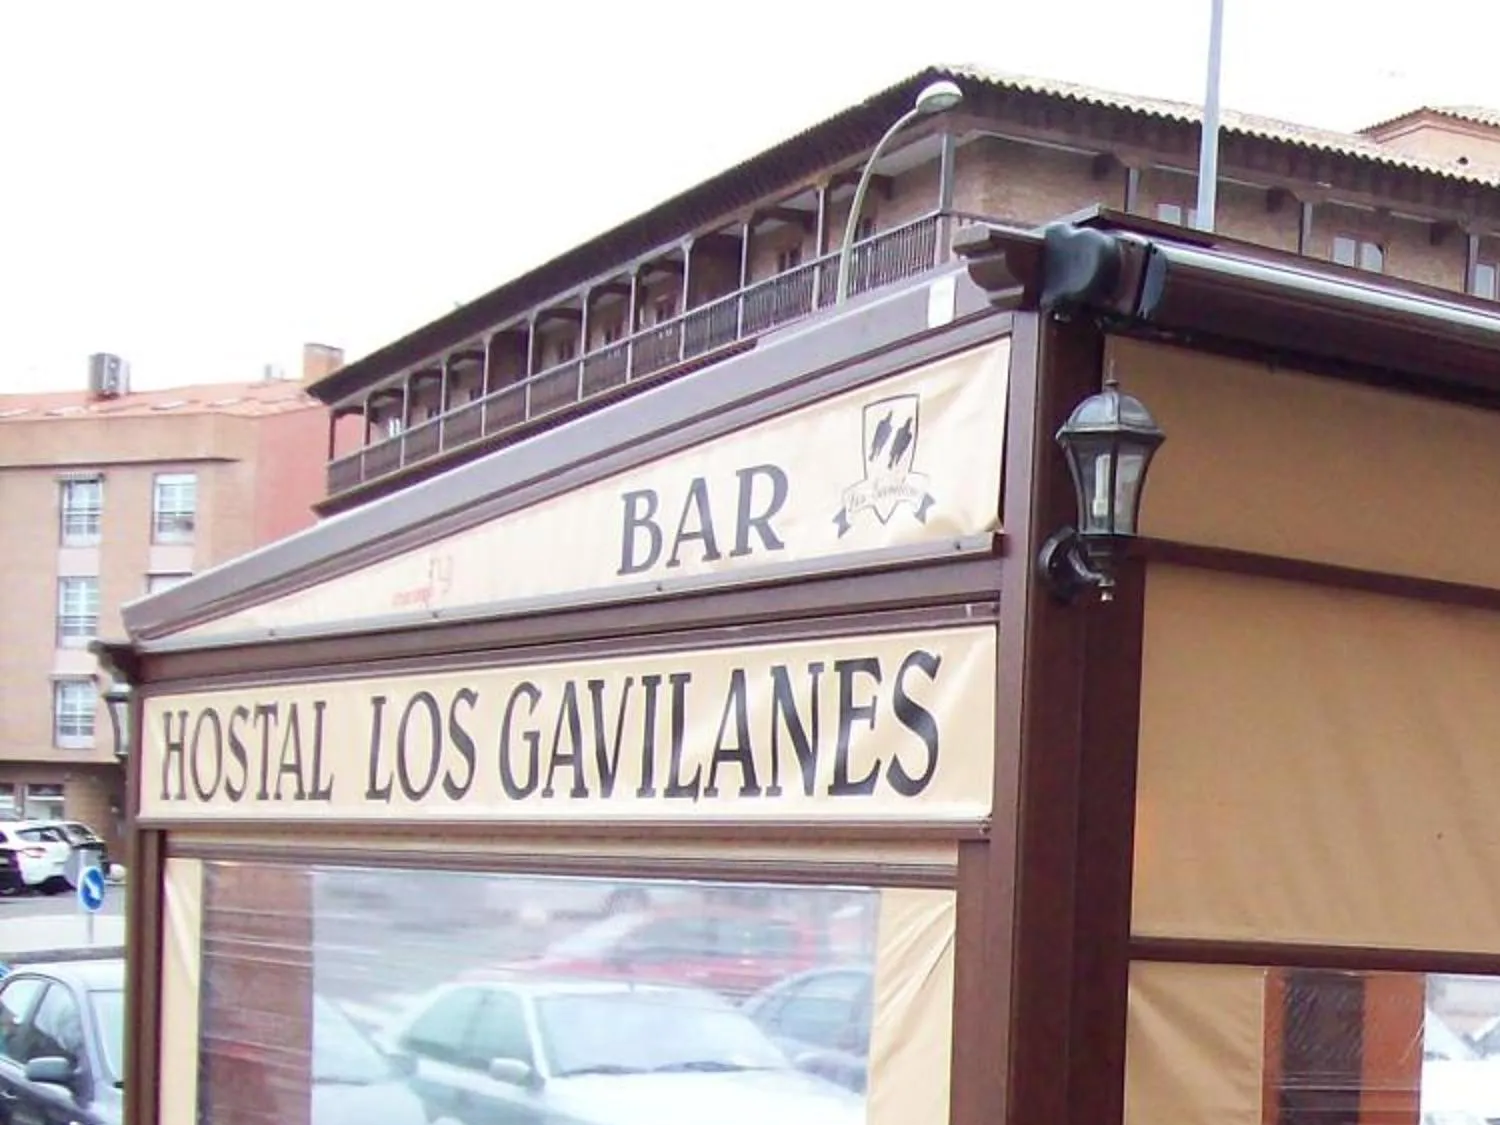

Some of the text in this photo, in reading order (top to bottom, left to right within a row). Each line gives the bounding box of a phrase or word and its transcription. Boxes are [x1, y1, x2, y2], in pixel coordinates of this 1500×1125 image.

[616, 464, 790, 576] BAR
[161, 650, 942, 802] HOSTAL LOS GAVILANES
